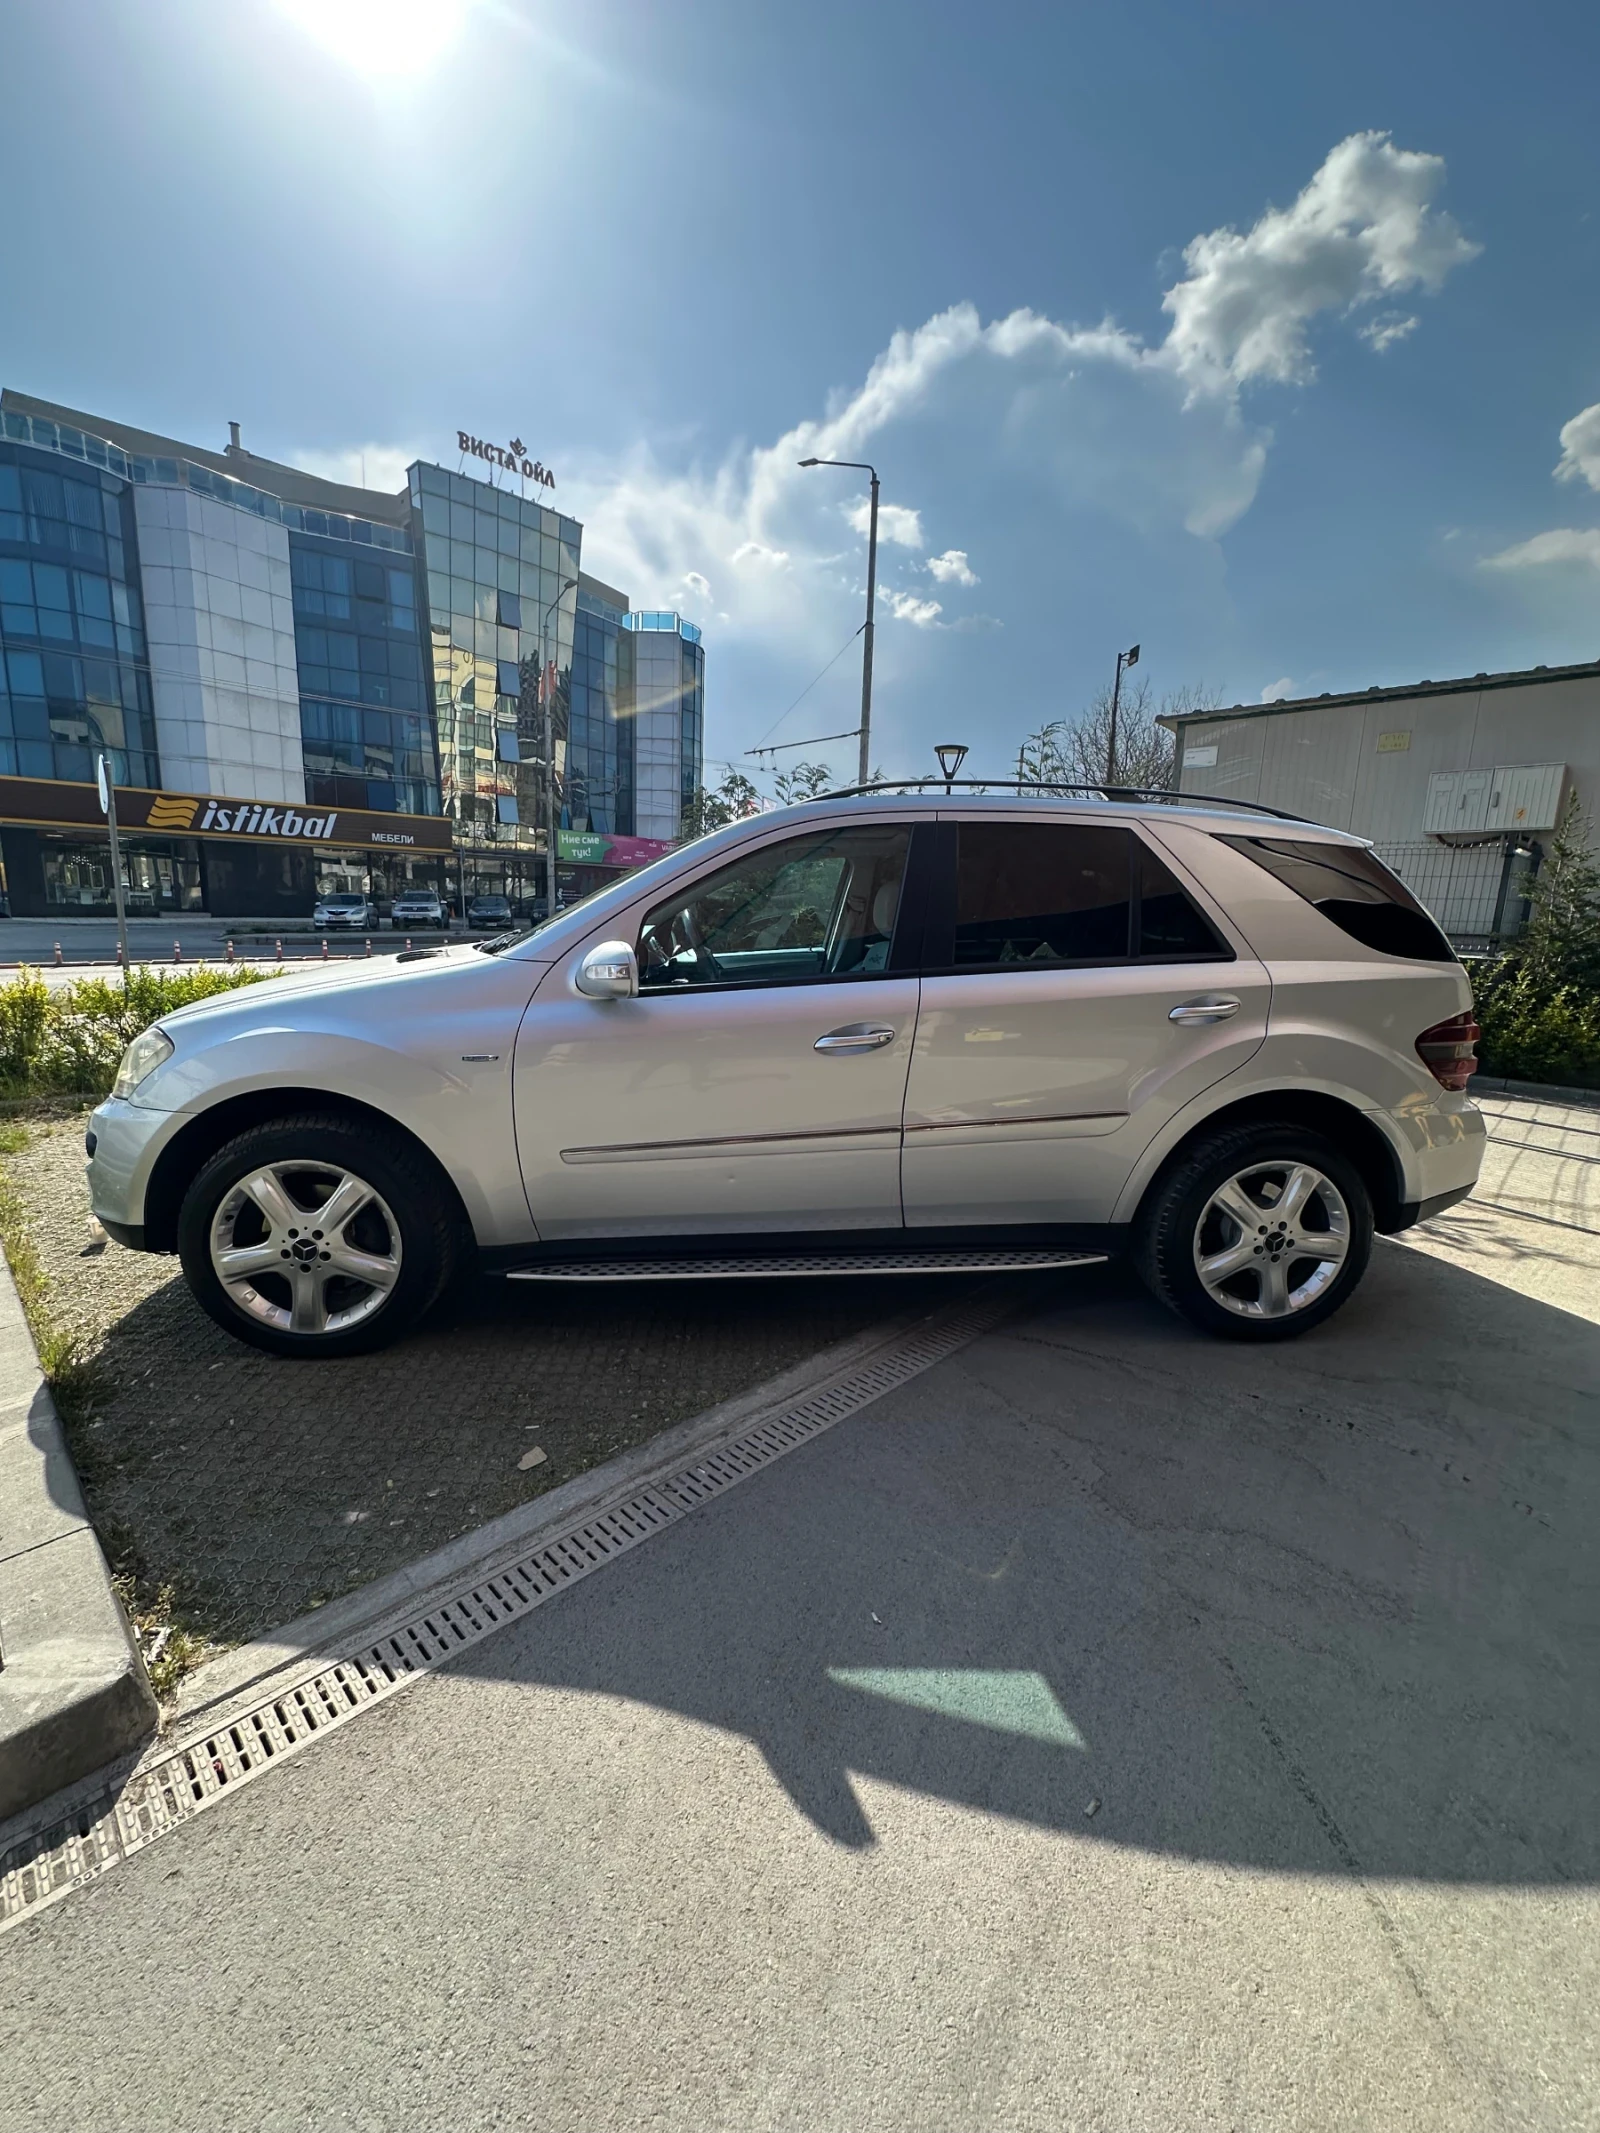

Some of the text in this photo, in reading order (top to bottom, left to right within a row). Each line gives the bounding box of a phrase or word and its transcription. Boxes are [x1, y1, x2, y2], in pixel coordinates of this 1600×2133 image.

[457, 430, 556, 489] ВИСТА ОЙЛ
[200, 800, 338, 839] istikbal
[371, 832, 415, 845] МЕБЕЛИ
[561, 833, 600, 845] Ние сме
[571, 847, 592, 859] тук!
